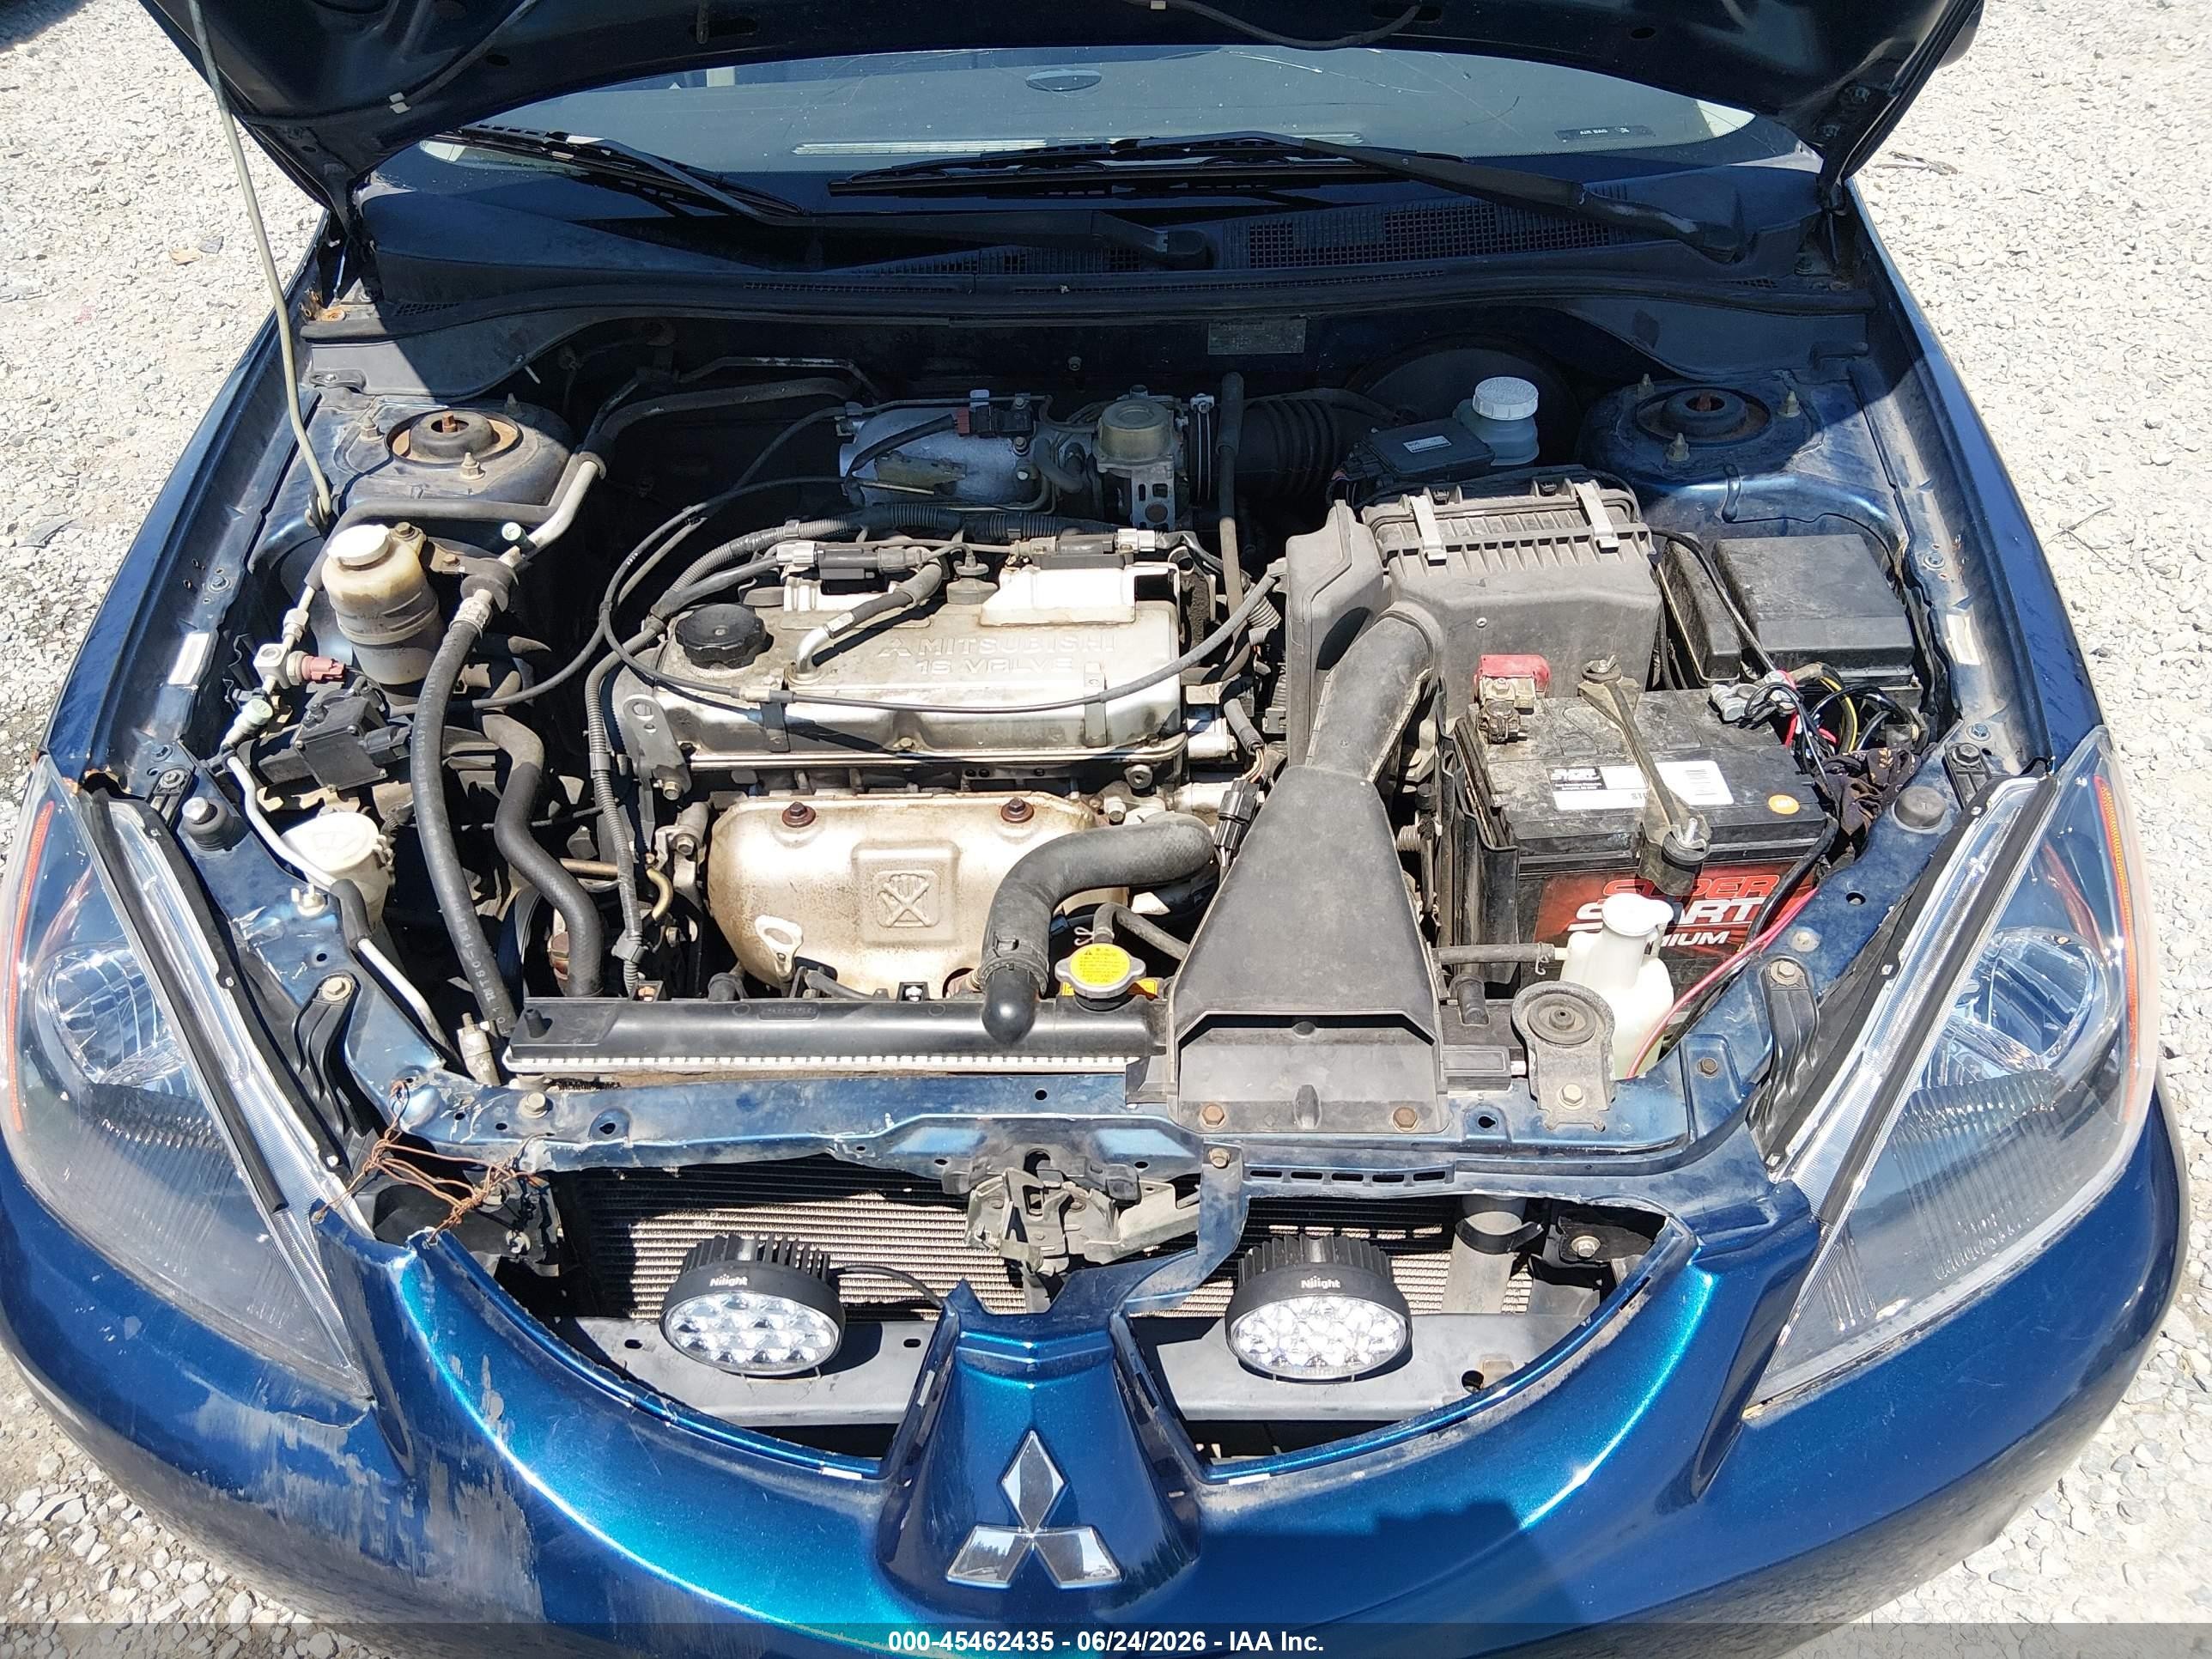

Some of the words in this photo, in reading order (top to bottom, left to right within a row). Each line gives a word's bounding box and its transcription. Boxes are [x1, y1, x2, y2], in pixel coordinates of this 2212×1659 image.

[918, 635, 1116, 656] MITSUBISHI
[915, 659, 951, 676] 16
[964, 658, 1073, 674] VALVE
[709, 1273, 748, 1286] Nilight
[1301, 1275, 1341, 1289] Nilight
